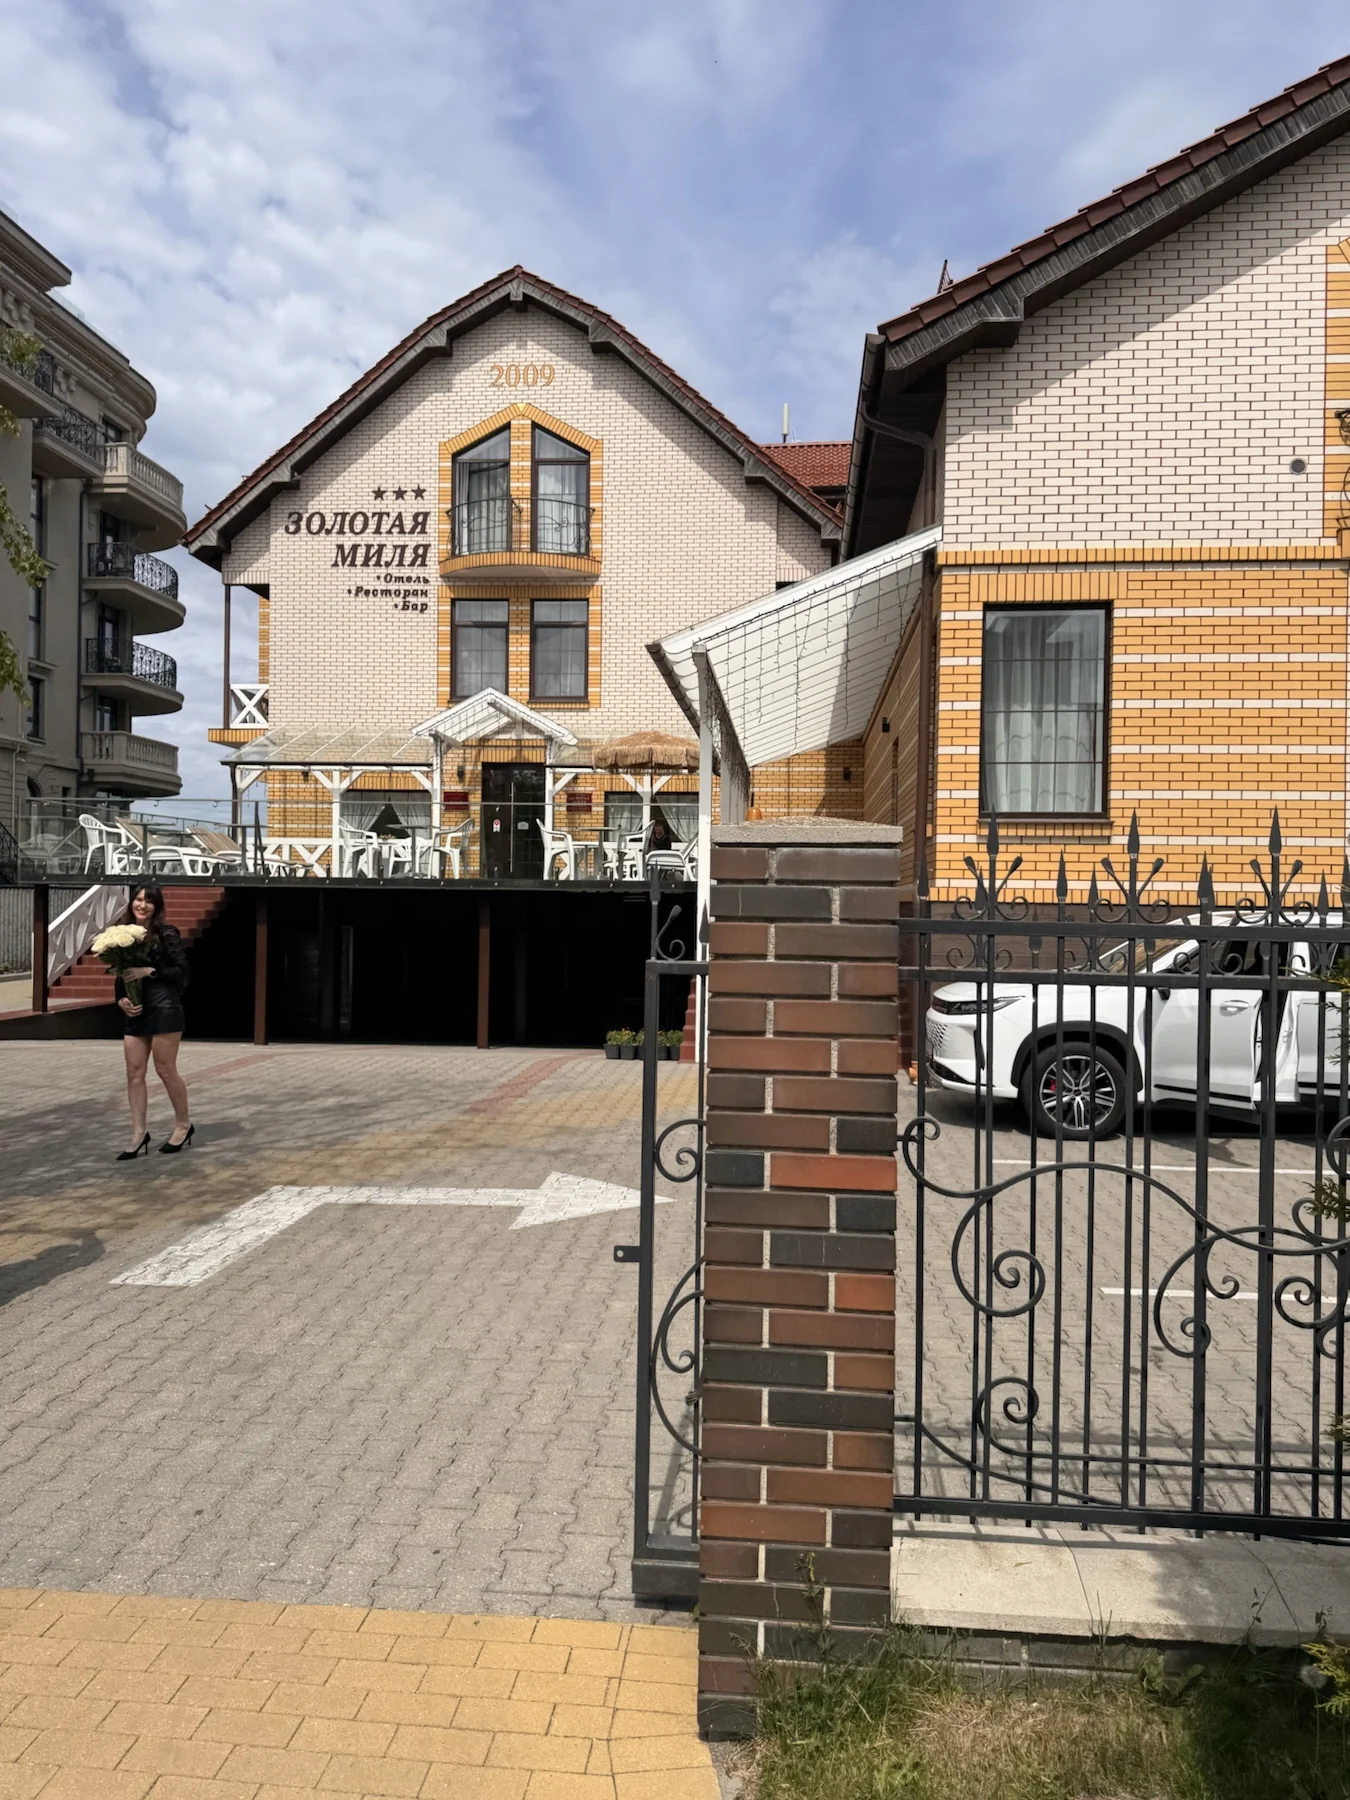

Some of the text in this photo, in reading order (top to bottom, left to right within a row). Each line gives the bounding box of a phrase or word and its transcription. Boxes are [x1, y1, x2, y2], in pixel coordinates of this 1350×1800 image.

[489, 364, 556, 388] 2009
[284, 511, 430, 535] ЗОЛОТАЯ
[331, 543, 431, 568] МИЛЯ
